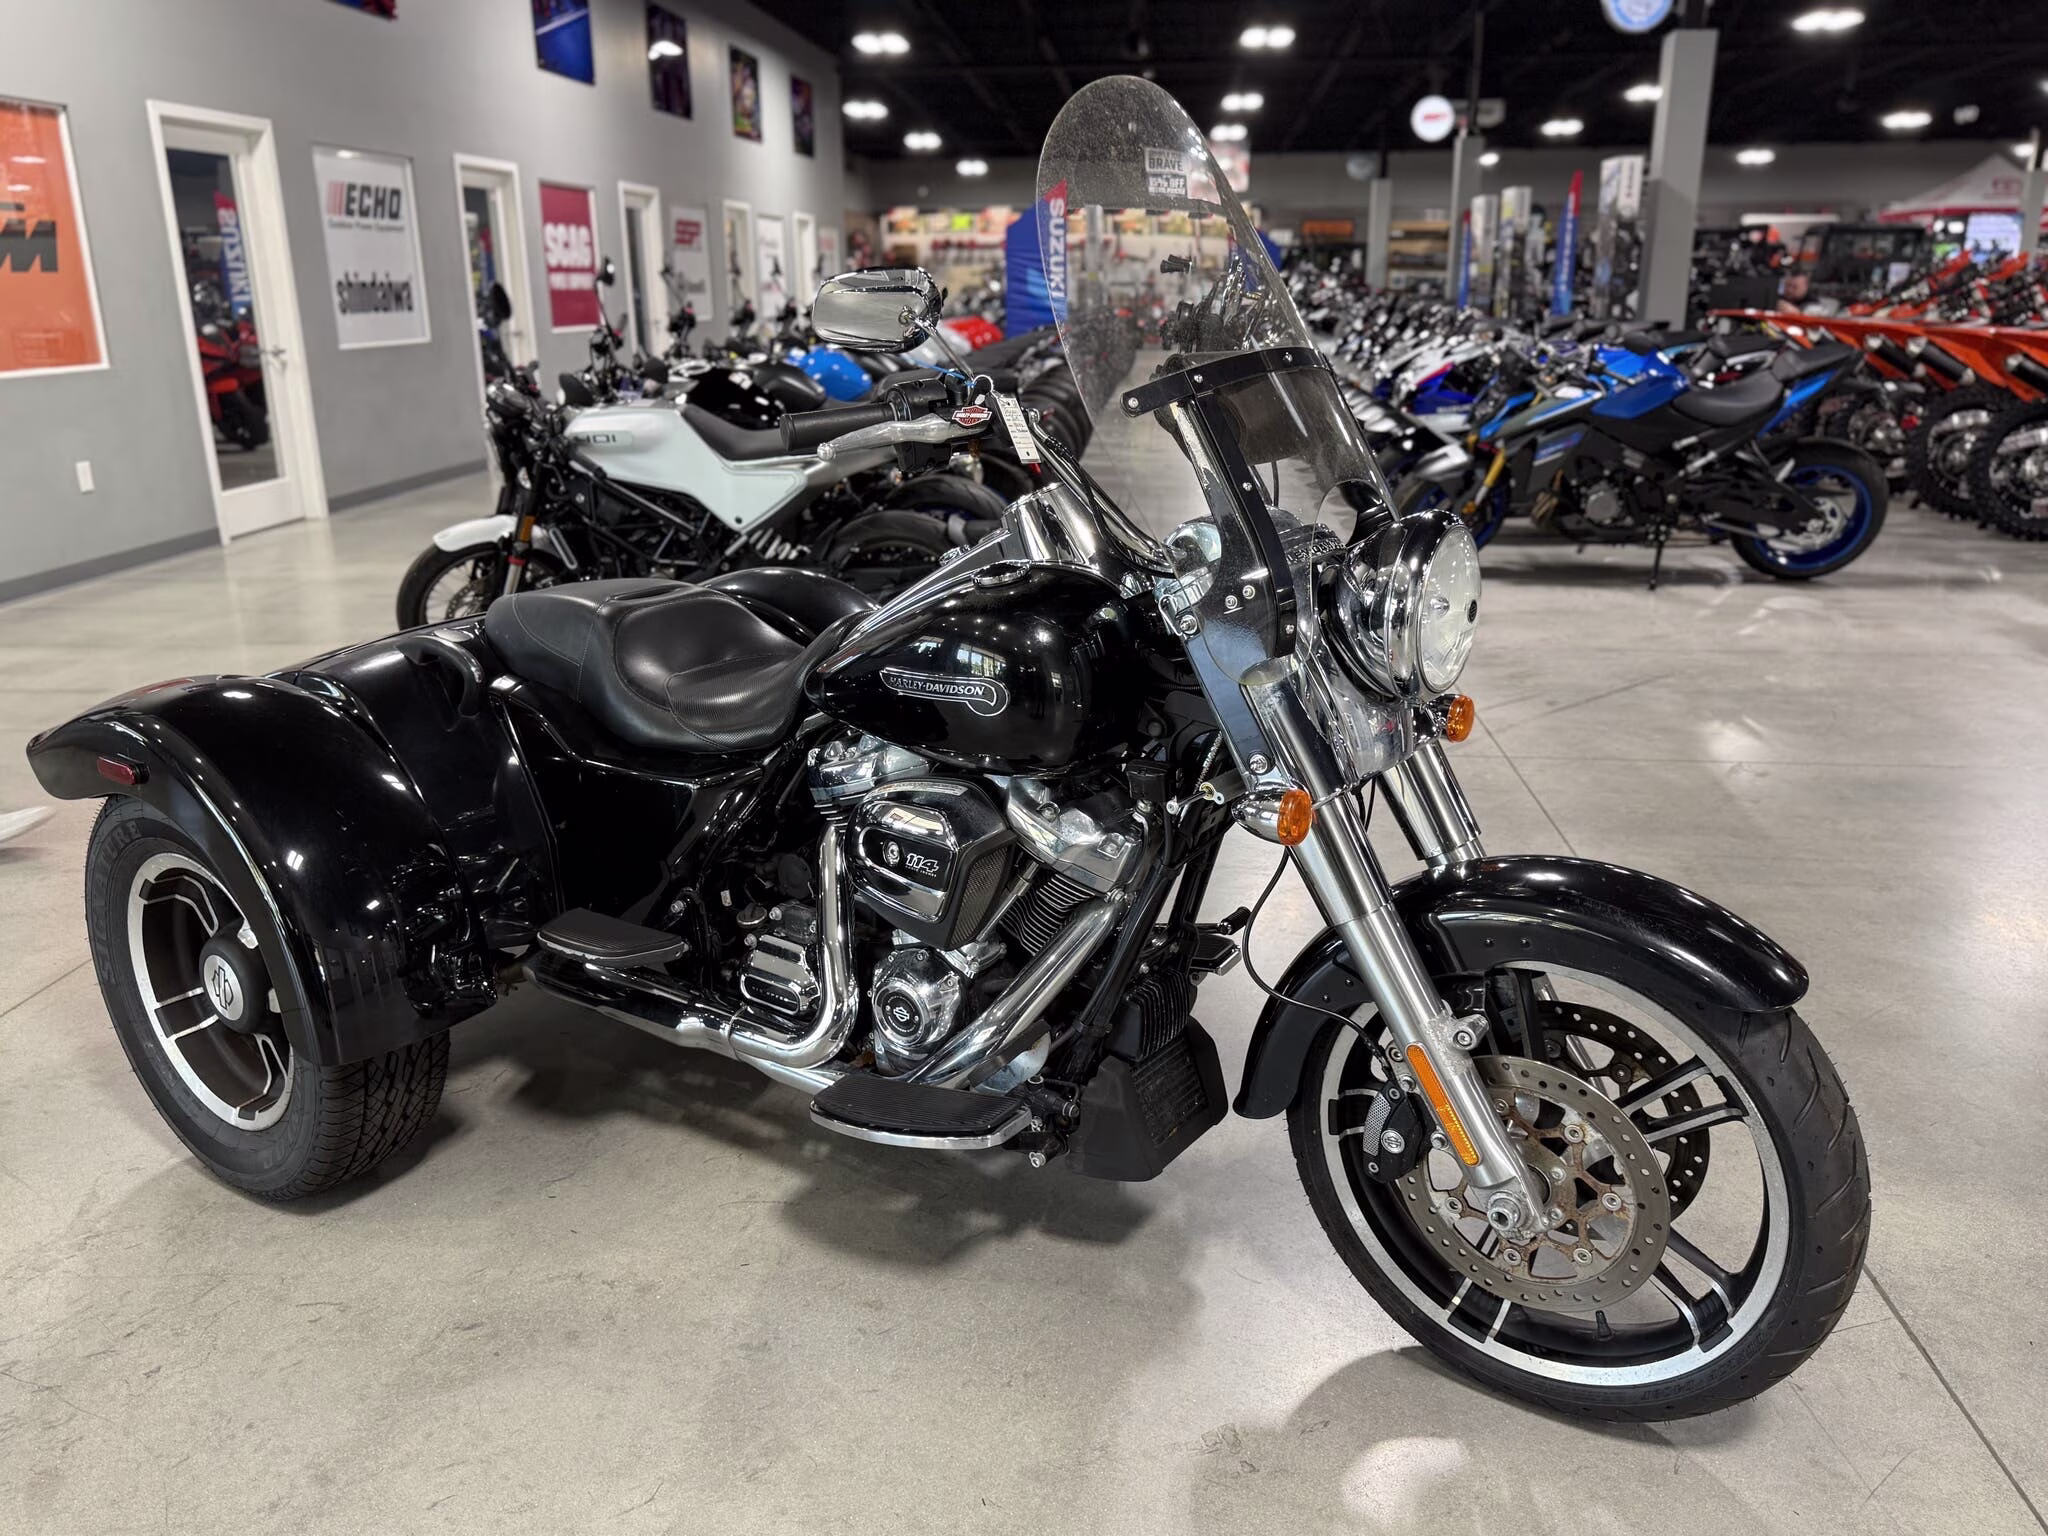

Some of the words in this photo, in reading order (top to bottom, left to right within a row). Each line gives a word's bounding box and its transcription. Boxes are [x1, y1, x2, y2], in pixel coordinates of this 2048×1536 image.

[345, 182, 402, 220] ECHO
[1049, 197, 1065, 298] SUZUKI
[905, 852, 940, 873] 114
